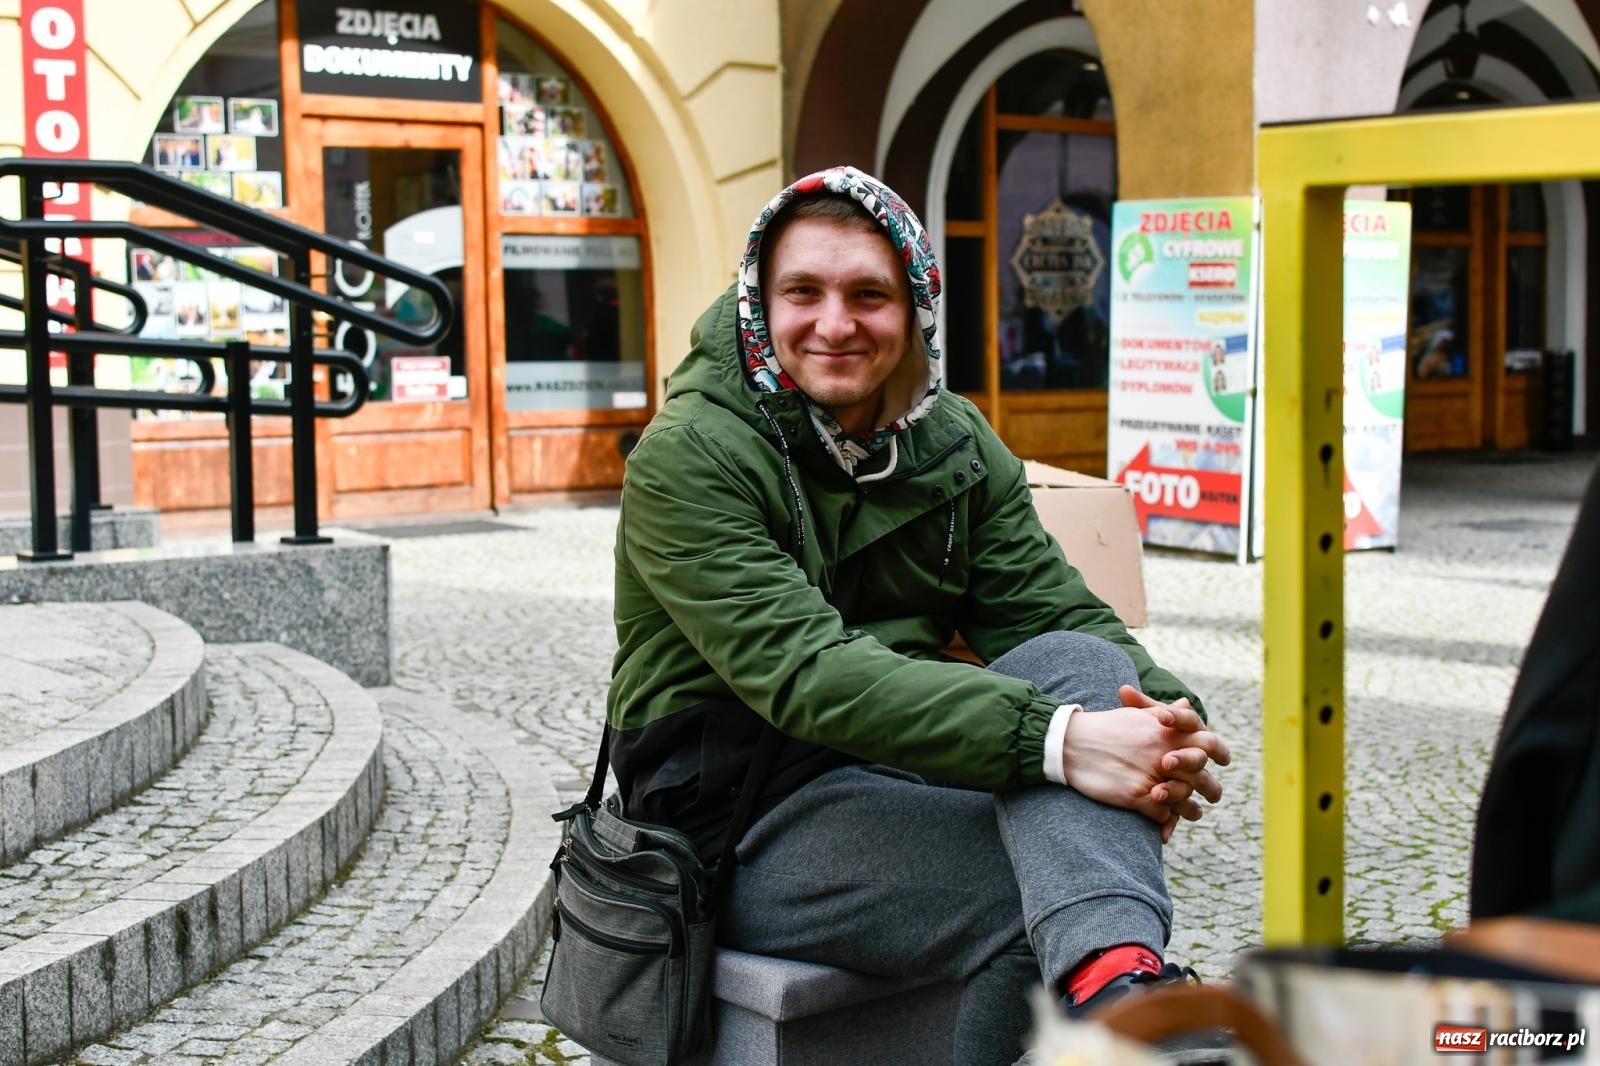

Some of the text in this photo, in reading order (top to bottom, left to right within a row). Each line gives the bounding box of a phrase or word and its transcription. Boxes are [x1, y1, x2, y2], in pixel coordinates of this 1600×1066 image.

[335, 7, 442, 42] ZDJĘCIA
[303, 44, 473, 82] DOKUMENTY
[1140, 211, 1232, 235] ZDJĘCIA
[1343, 213, 1387, 234] CIA
[1163, 240, 1244, 258] CYFROWE
[1124, 470, 1200, 509] FOTO
